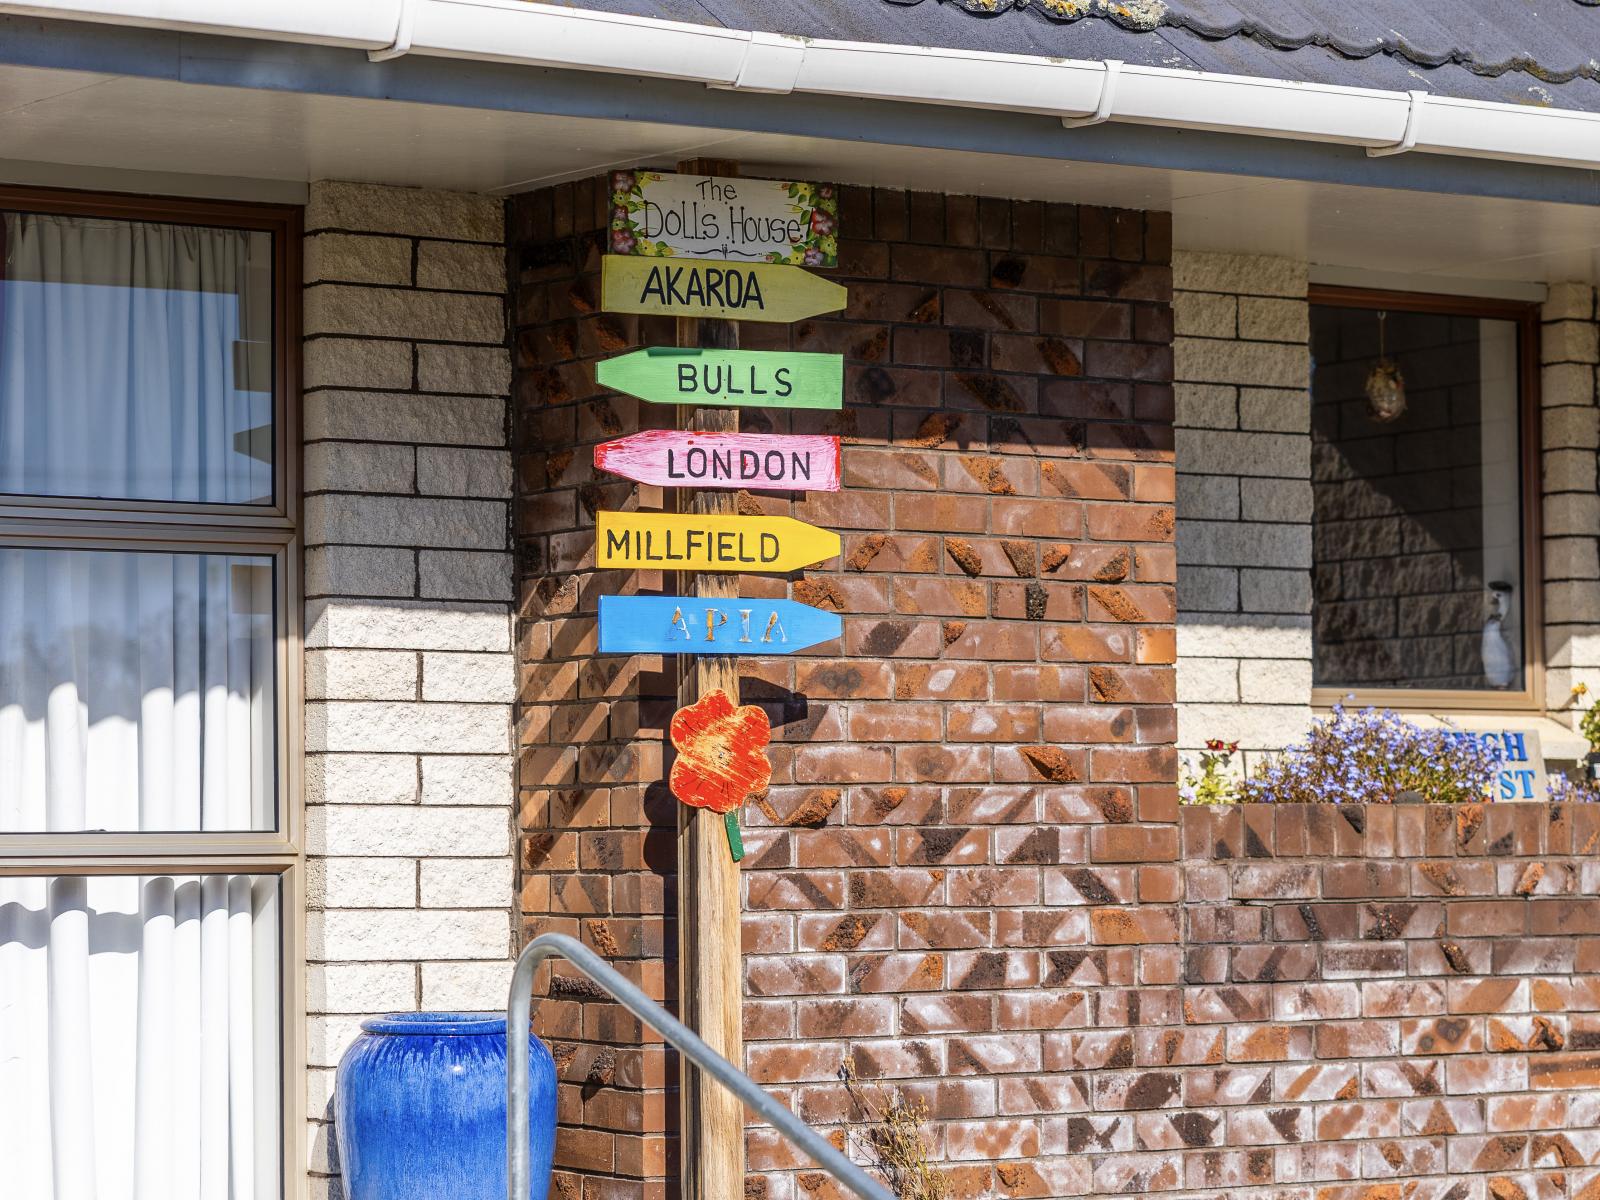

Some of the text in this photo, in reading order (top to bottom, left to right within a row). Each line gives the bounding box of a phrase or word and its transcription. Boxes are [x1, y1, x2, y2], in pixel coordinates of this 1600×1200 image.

[695, 176, 738, 201] The
[729, 206, 803, 244] House
[640, 265, 765, 310] AKAROA
[677, 363, 793, 397] BULLS
[667, 447, 811, 481] LONDON
[606, 529, 780, 563] MILLFIELD
[665, 605, 788, 643] APIA
[1499, 769, 1536, 800] ST
